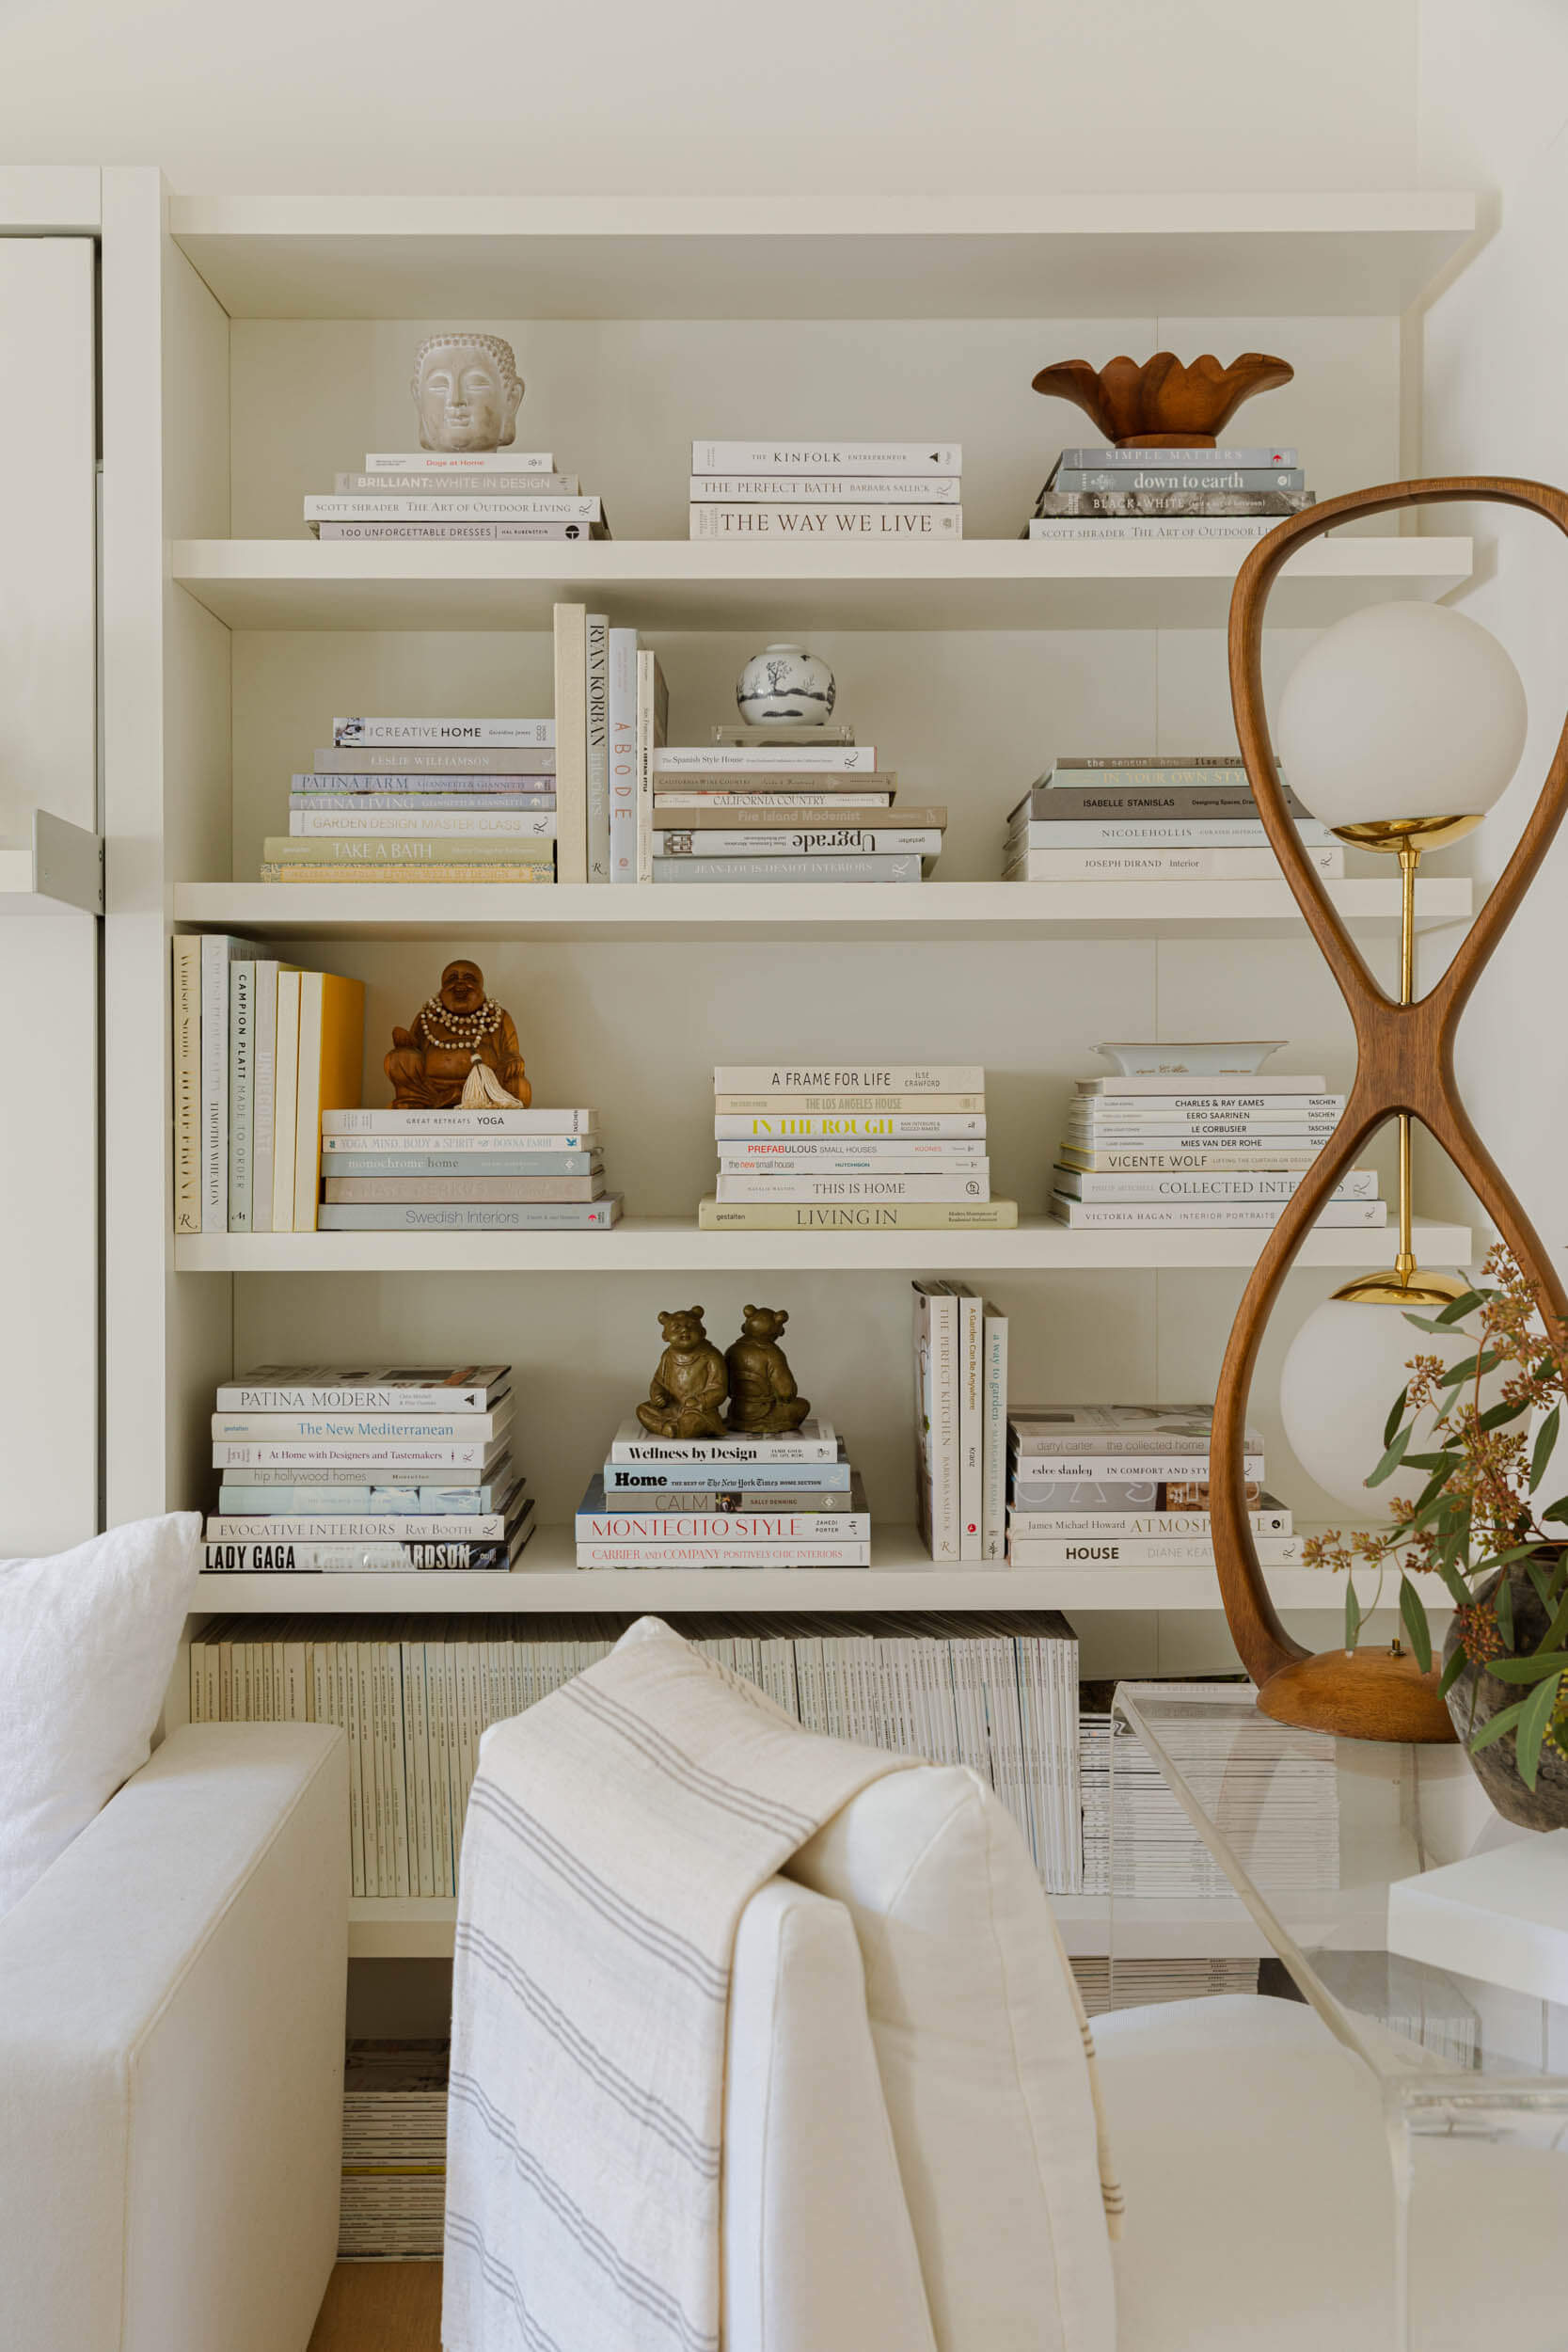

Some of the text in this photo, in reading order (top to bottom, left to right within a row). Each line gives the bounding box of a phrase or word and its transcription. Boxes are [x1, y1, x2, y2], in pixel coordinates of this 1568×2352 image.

[1105, 451, 1243, 460] SIMPLE MATTERS
[357, 477, 550, 489] BRILLIANT: WHITE IN DESIGN
[1134, 472, 1243, 489] down to earth
[703, 482, 843, 493] THE PERFECT BATH
[721, 514, 933, 532] THE WAY WE LIVE
[341, 528, 491, 537] 100 UNFORGETTABLE DRESSES
[590, 625, 606, 747] RYAN KORBAN
[374, 726, 483, 738] CREATIVE HOME
[371, 755, 490, 767] LESLIE WILLIAMSON
[1102, 772, 1119, 784] IN
[1125, 771, 1165, 784] YOUR
[1171, 771, 1208, 784] OWN
[1083, 799, 1123, 807] ISABELLE
[738, 811, 863, 821] Fire Island Modernist
[312, 818, 521, 831] GARDEN DESIGN MASTER CLASS
[1101, 829, 1193, 837] NICOLEHOLLIS
[792, 832, 876, 852] Upgrade
[332, 842, 371, 859] TAKE
[375, 843, 388, 859] A
[390, 842, 433, 859] BATH
[1085, 859, 1199, 868] JOSEPH DIRAND Interior
[236, 974, 246, 1189] CAMPION PLATT MADE TO ORDER
[771, 1073, 892, 1086] A FRAME FOR LIFE
[805, 1098, 902, 1110] THE LOS ANGELES HOUSE
[210, 1102, 219, 1149] TIMOTHY
[477, 1117, 504, 1125] YOGA
[752, 1119, 894, 1135] IN THE ROUGH
[748, 1145, 877, 1153] PREFABULOUS SMALL HOUSES
[348, 1158, 459, 1168] monochrome home
[1108, 1155, 1208, 1168] VICENTE WOLF
[813, 1183, 905, 1194] THIS IS HOME
[405, 1210, 465, 1224] Swedish
[467, 1210, 520, 1224] Interiors
[716, 1213, 745, 1221] gestalten
[797, 1209, 897, 1224] LIVING IN
[1085, 1212, 1173, 1220] VICTORIA HAGAN
[989, 1343, 1002, 1362] way
[969, 1360, 976, 1371] Be
[992, 1368, 1001, 1379] to
[967, 1372, 976, 1410] Anywhere
[241, 1391, 390, 1406] PATINA MODERN
[989, 1381, 1003, 1421] garden
[297, 1422, 453, 1436] The New Mediterranean
[269, 1451, 442, 1461] At Home with Designers and Tastemakers
[629, 1447, 757, 1462] Wellness by Design
[254, 1470, 367, 1482] hip hollywood homes
[615, 1472, 668, 1486] Home
[707, 1478, 721, 1487] The
[721, 1478, 736, 1487] New
[737, 1478, 756, 1488] York
[756, 1478, 779, 1486] Times
[655, 1495, 708, 1511] CALM
[219, 1523, 395, 1536] EVOCATIVE INTERIORS
[592, 1518, 802, 1536] MONTECITO STYLE
[1028, 1519, 1125, 1530] James Michael Howard
[205, 1545, 295, 1569] LADY GAGA
[592, 1549, 641, 1560] CARRIER
[663, 1549, 721, 1560] COMPANY
[723, 1549, 770, 1559] POSITIVELY
[772, 1549, 795, 1559] CHIC
[797, 1549, 843, 1559] INTERIORS
[1066, 1548, 1119, 1559] HOUSE
